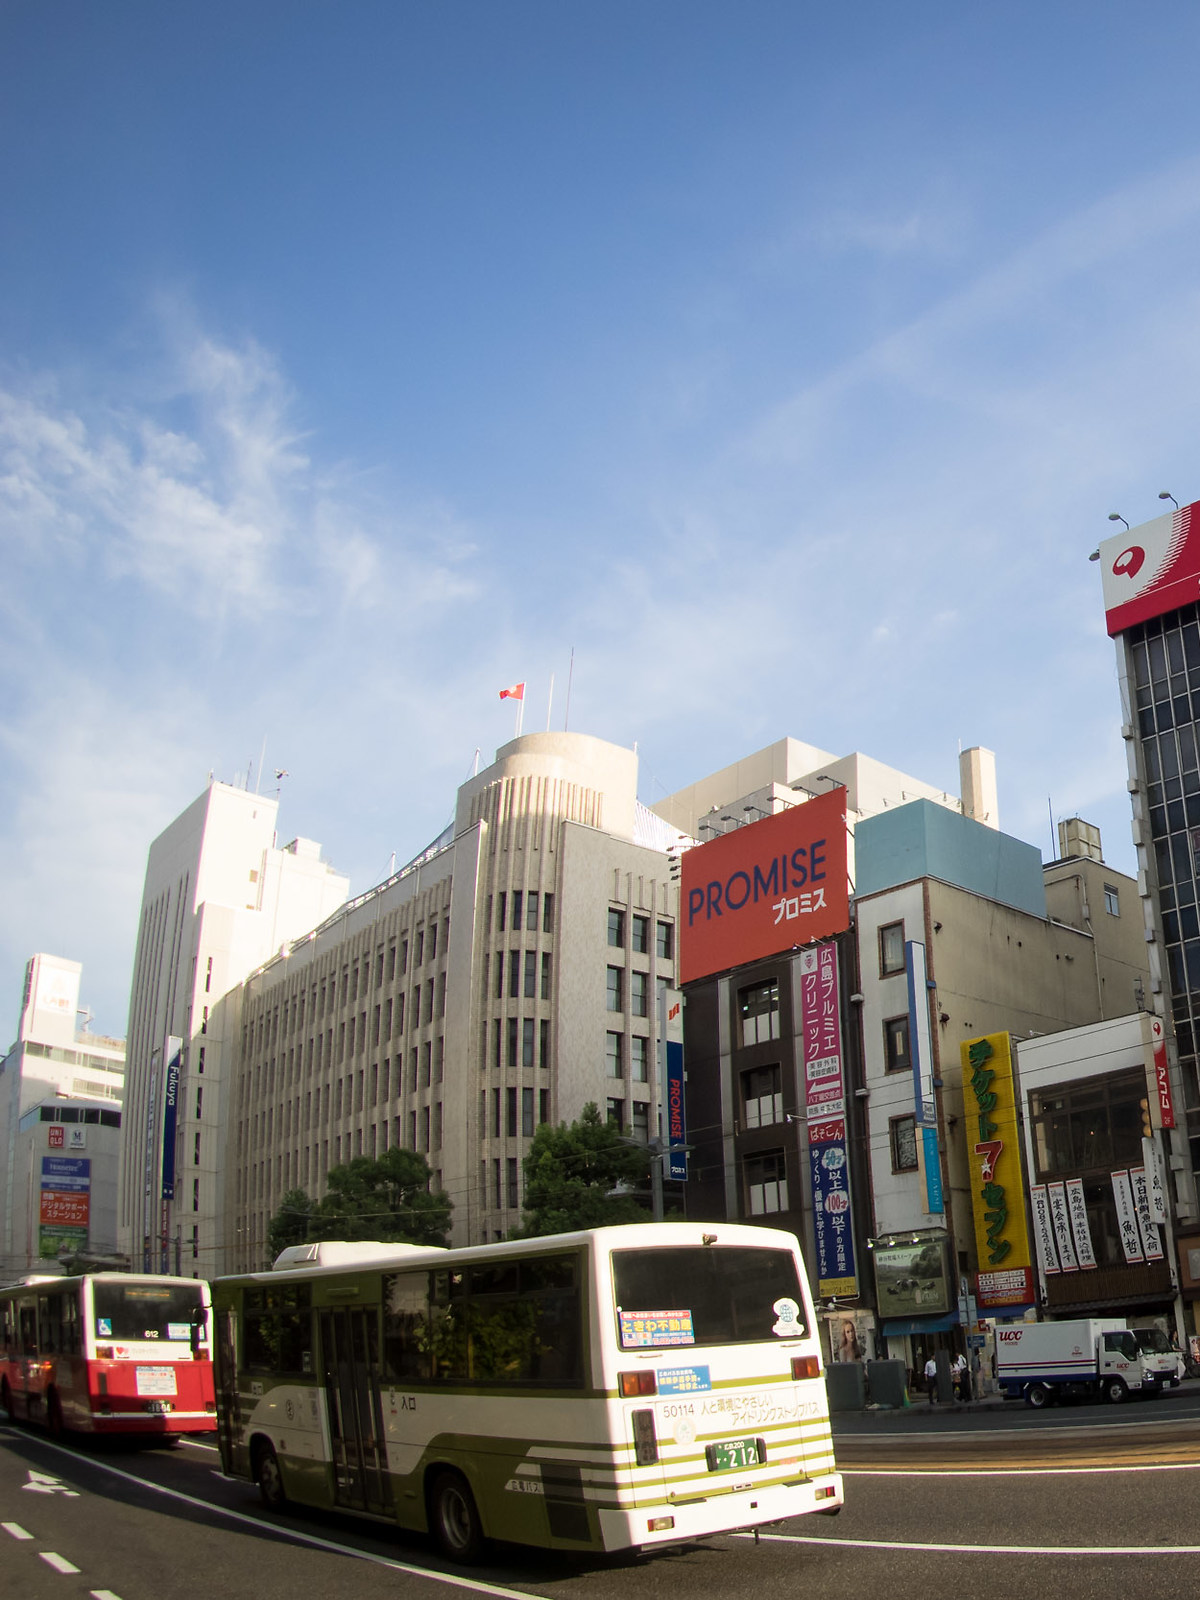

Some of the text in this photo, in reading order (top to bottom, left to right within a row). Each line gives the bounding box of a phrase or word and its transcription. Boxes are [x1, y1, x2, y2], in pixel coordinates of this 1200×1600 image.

[689, 839, 827, 927] PROMISE
[772, 887, 827, 925] プロミス
[820, 948, 837, 1051] 広島プルミエ
[805, 974, 820, 1060] クリニック
[168, 1065, 180, 1107] Fukuya
[1157, 1066, 1170, 1109] アコム
[670, 1078, 682, 1139] PROMISE
[50, 1128, 63, 1136] UNI
[50, 1136, 63, 1145] QLO
[42, 1201, 88, 1211] デジタルサポート
[47, 1210, 83, 1219] ステーション
[1070, 1187, 1085, 1220] 広島地酒
[1052, 1199, 1071, 1263] 宴会承ります
[1121, 1220, 1138, 1255] 魚哲
[144, 1330, 159, 1338] 612
[622, 1319, 692, 1333] ときわ不動産
[401, 1397, 416, 1411] 入口
[663, 1403, 695, 1418] 50114
[701, 1394, 773, 1416] 人と環境にやさしい
[732, 1402, 820, 1426] アイドリングストップバス
